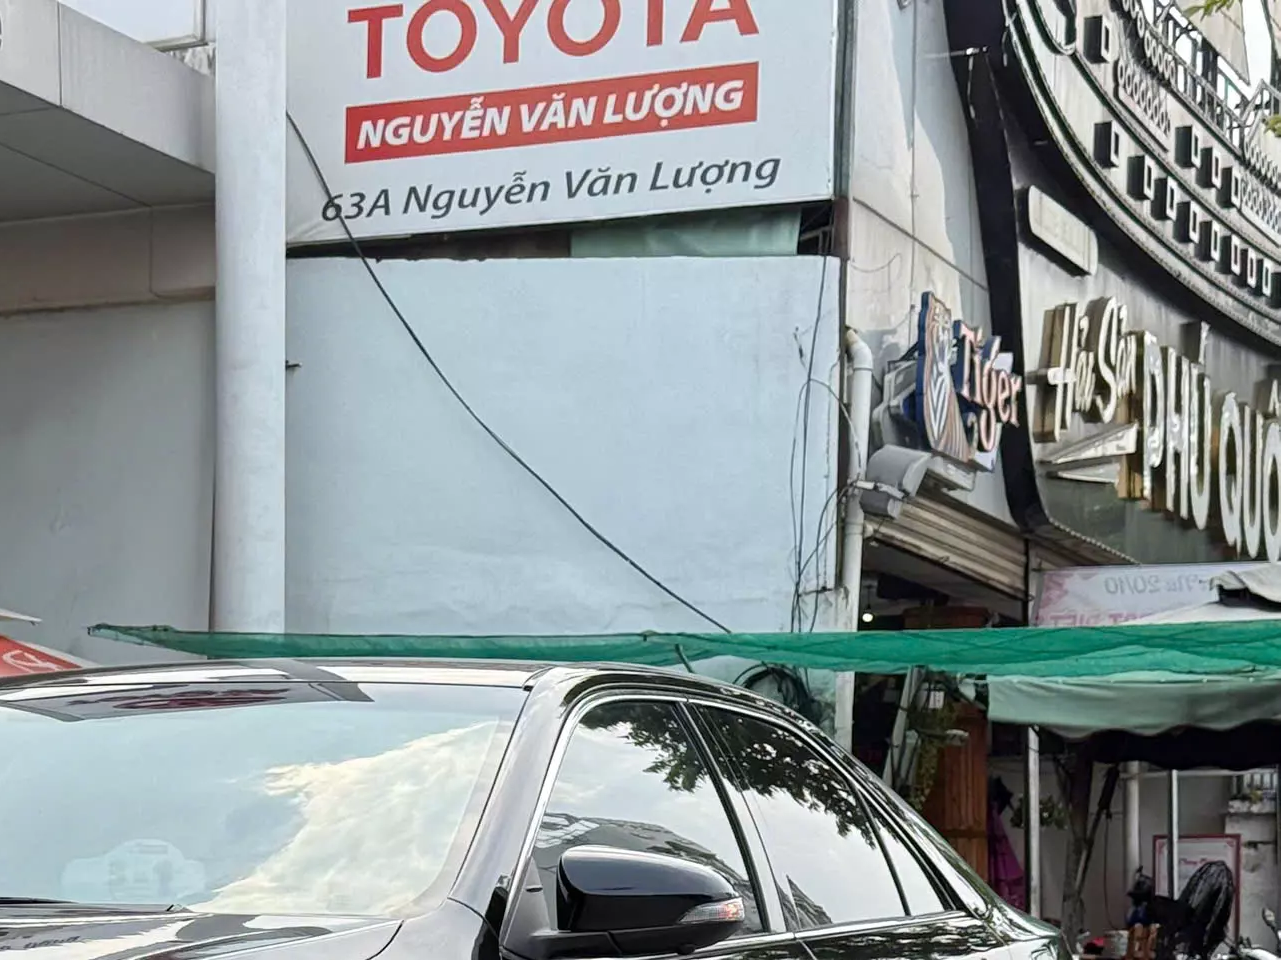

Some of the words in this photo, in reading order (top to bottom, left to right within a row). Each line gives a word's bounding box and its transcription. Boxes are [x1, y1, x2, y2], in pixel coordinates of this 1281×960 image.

[357, 98, 508, 150] NGUYỄN
[520, 93, 600, 132] VĂN
[602, 79, 744, 129] LƯỢNG
[321, 188, 391, 222] 63A
[402, 170, 551, 219] Nguyễn
[564, 165, 637, 200] Văn
[649, 156, 781, 194] Lượng
[955, 320, 1022, 453] Tiger
